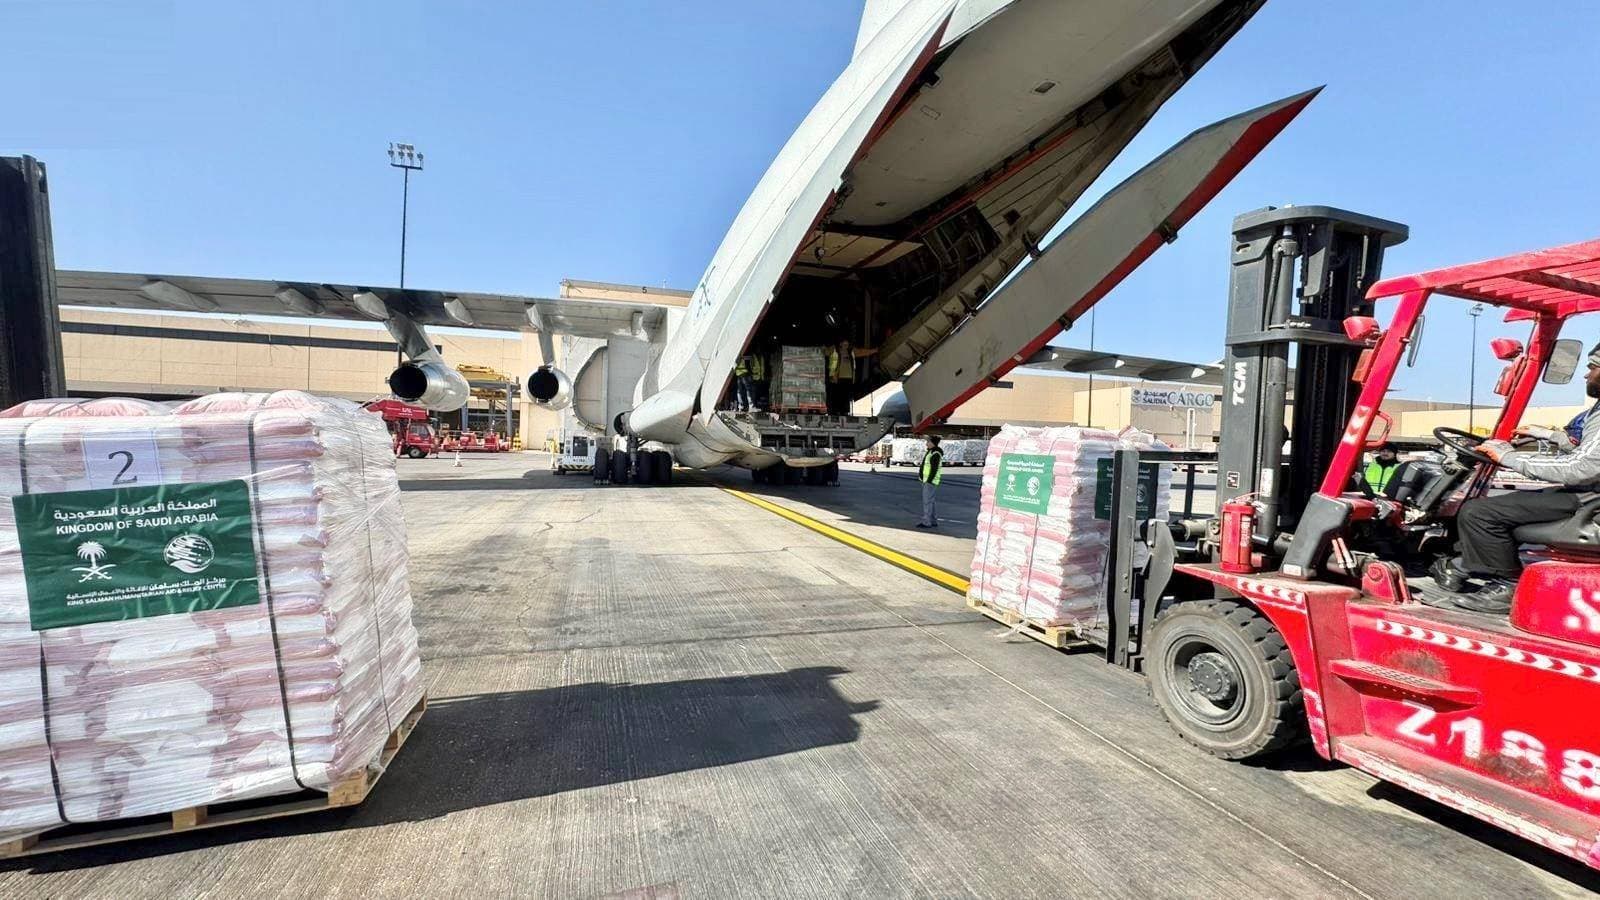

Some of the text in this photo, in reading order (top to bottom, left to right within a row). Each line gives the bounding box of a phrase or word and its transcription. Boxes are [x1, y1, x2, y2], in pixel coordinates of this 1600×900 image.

[641, 286, 648, 294] 5
[1232, 361, 1247, 406] TCM
[1167, 391, 1215, 407] CARGO
[108, 450, 138, 485] 2
[54, 498, 217, 521] المملكة العربية السعودية
[56, 512, 219, 535] KINGDOM OF SAUDI ARABIA
[85, 595, 114, 604] SALMAN
[114, 588, 164, 601] HUMANITARIAN
